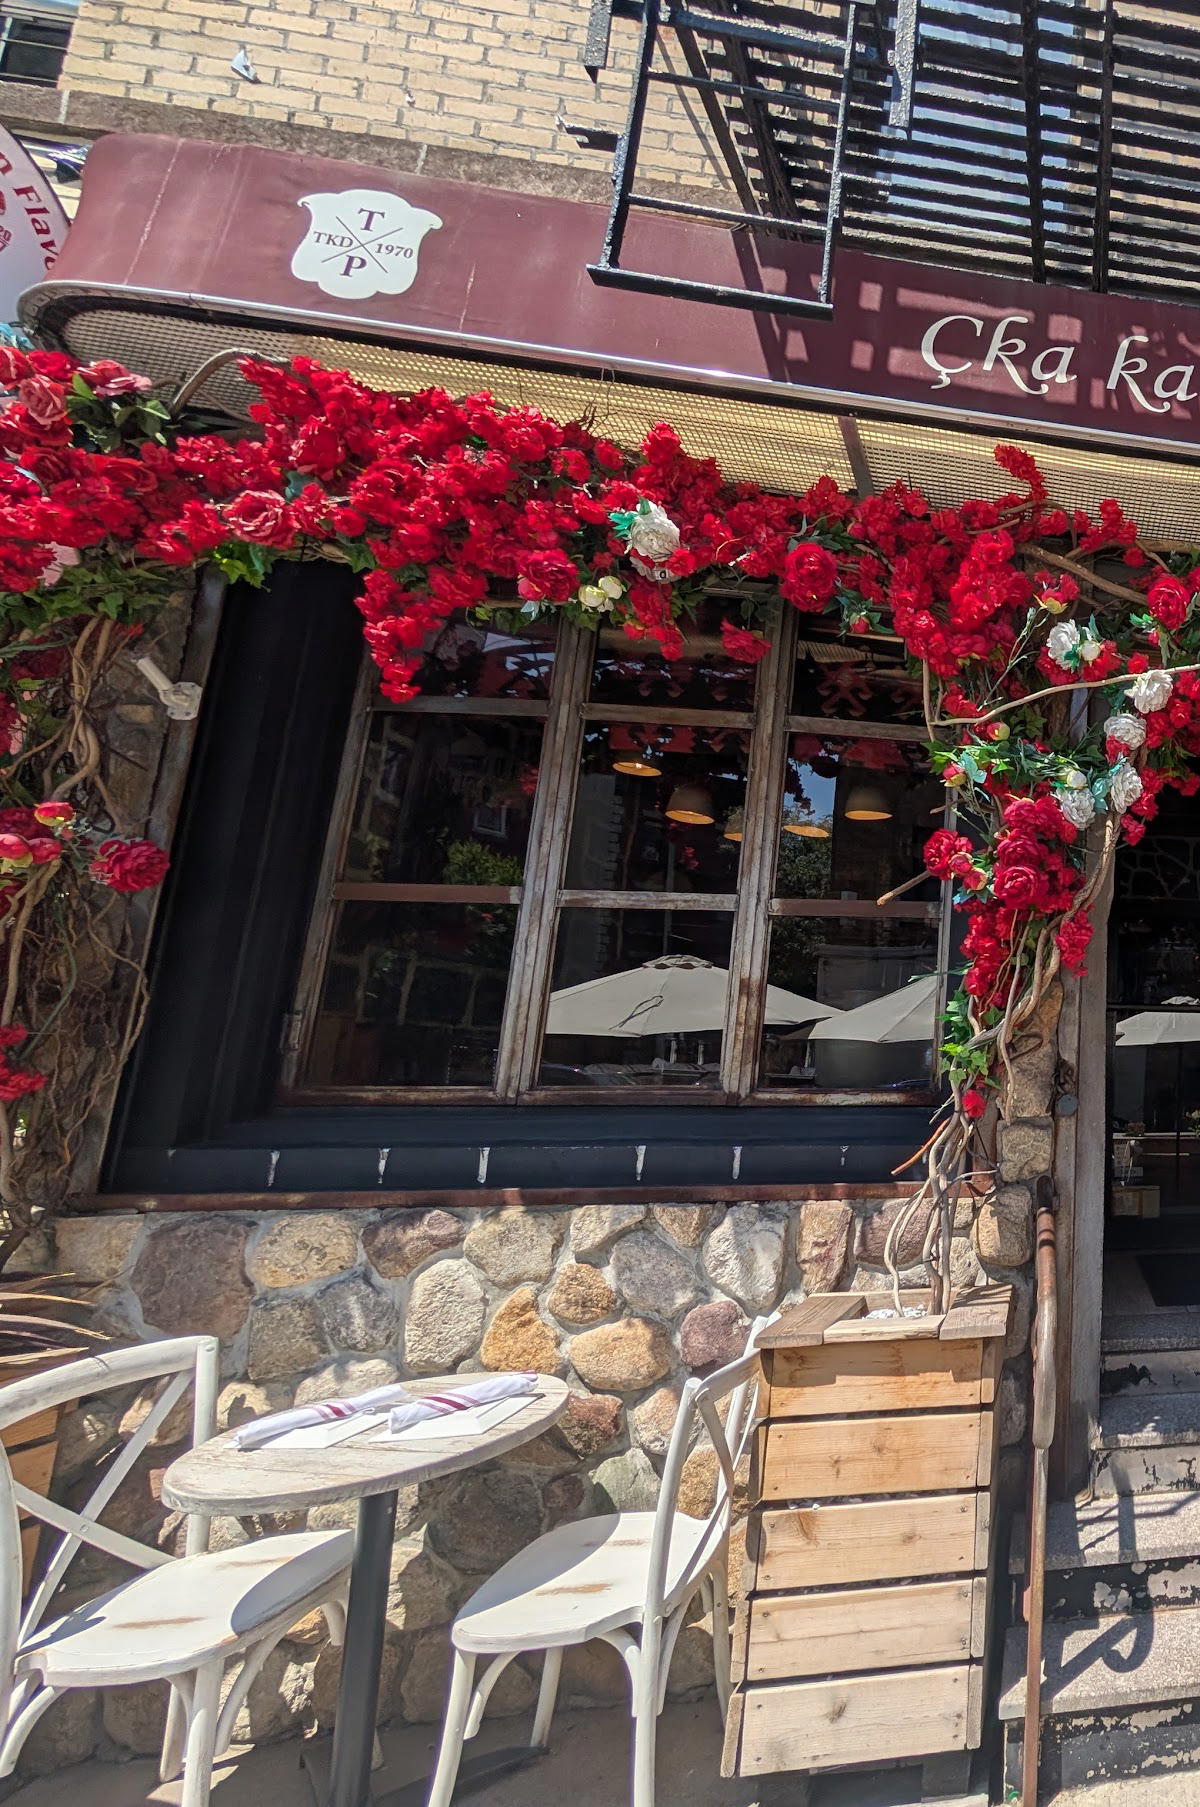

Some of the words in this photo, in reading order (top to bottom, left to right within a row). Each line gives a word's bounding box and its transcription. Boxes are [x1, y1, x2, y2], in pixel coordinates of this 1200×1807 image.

[357, 208, 386, 232] T
[313, 231, 354, 248] TKD
[375, 243, 414, 259] 1970
[339, 254, 367, 278] P
[921, 315, 1078, 395] Çka
[1106, 335, 1198, 413] ka
